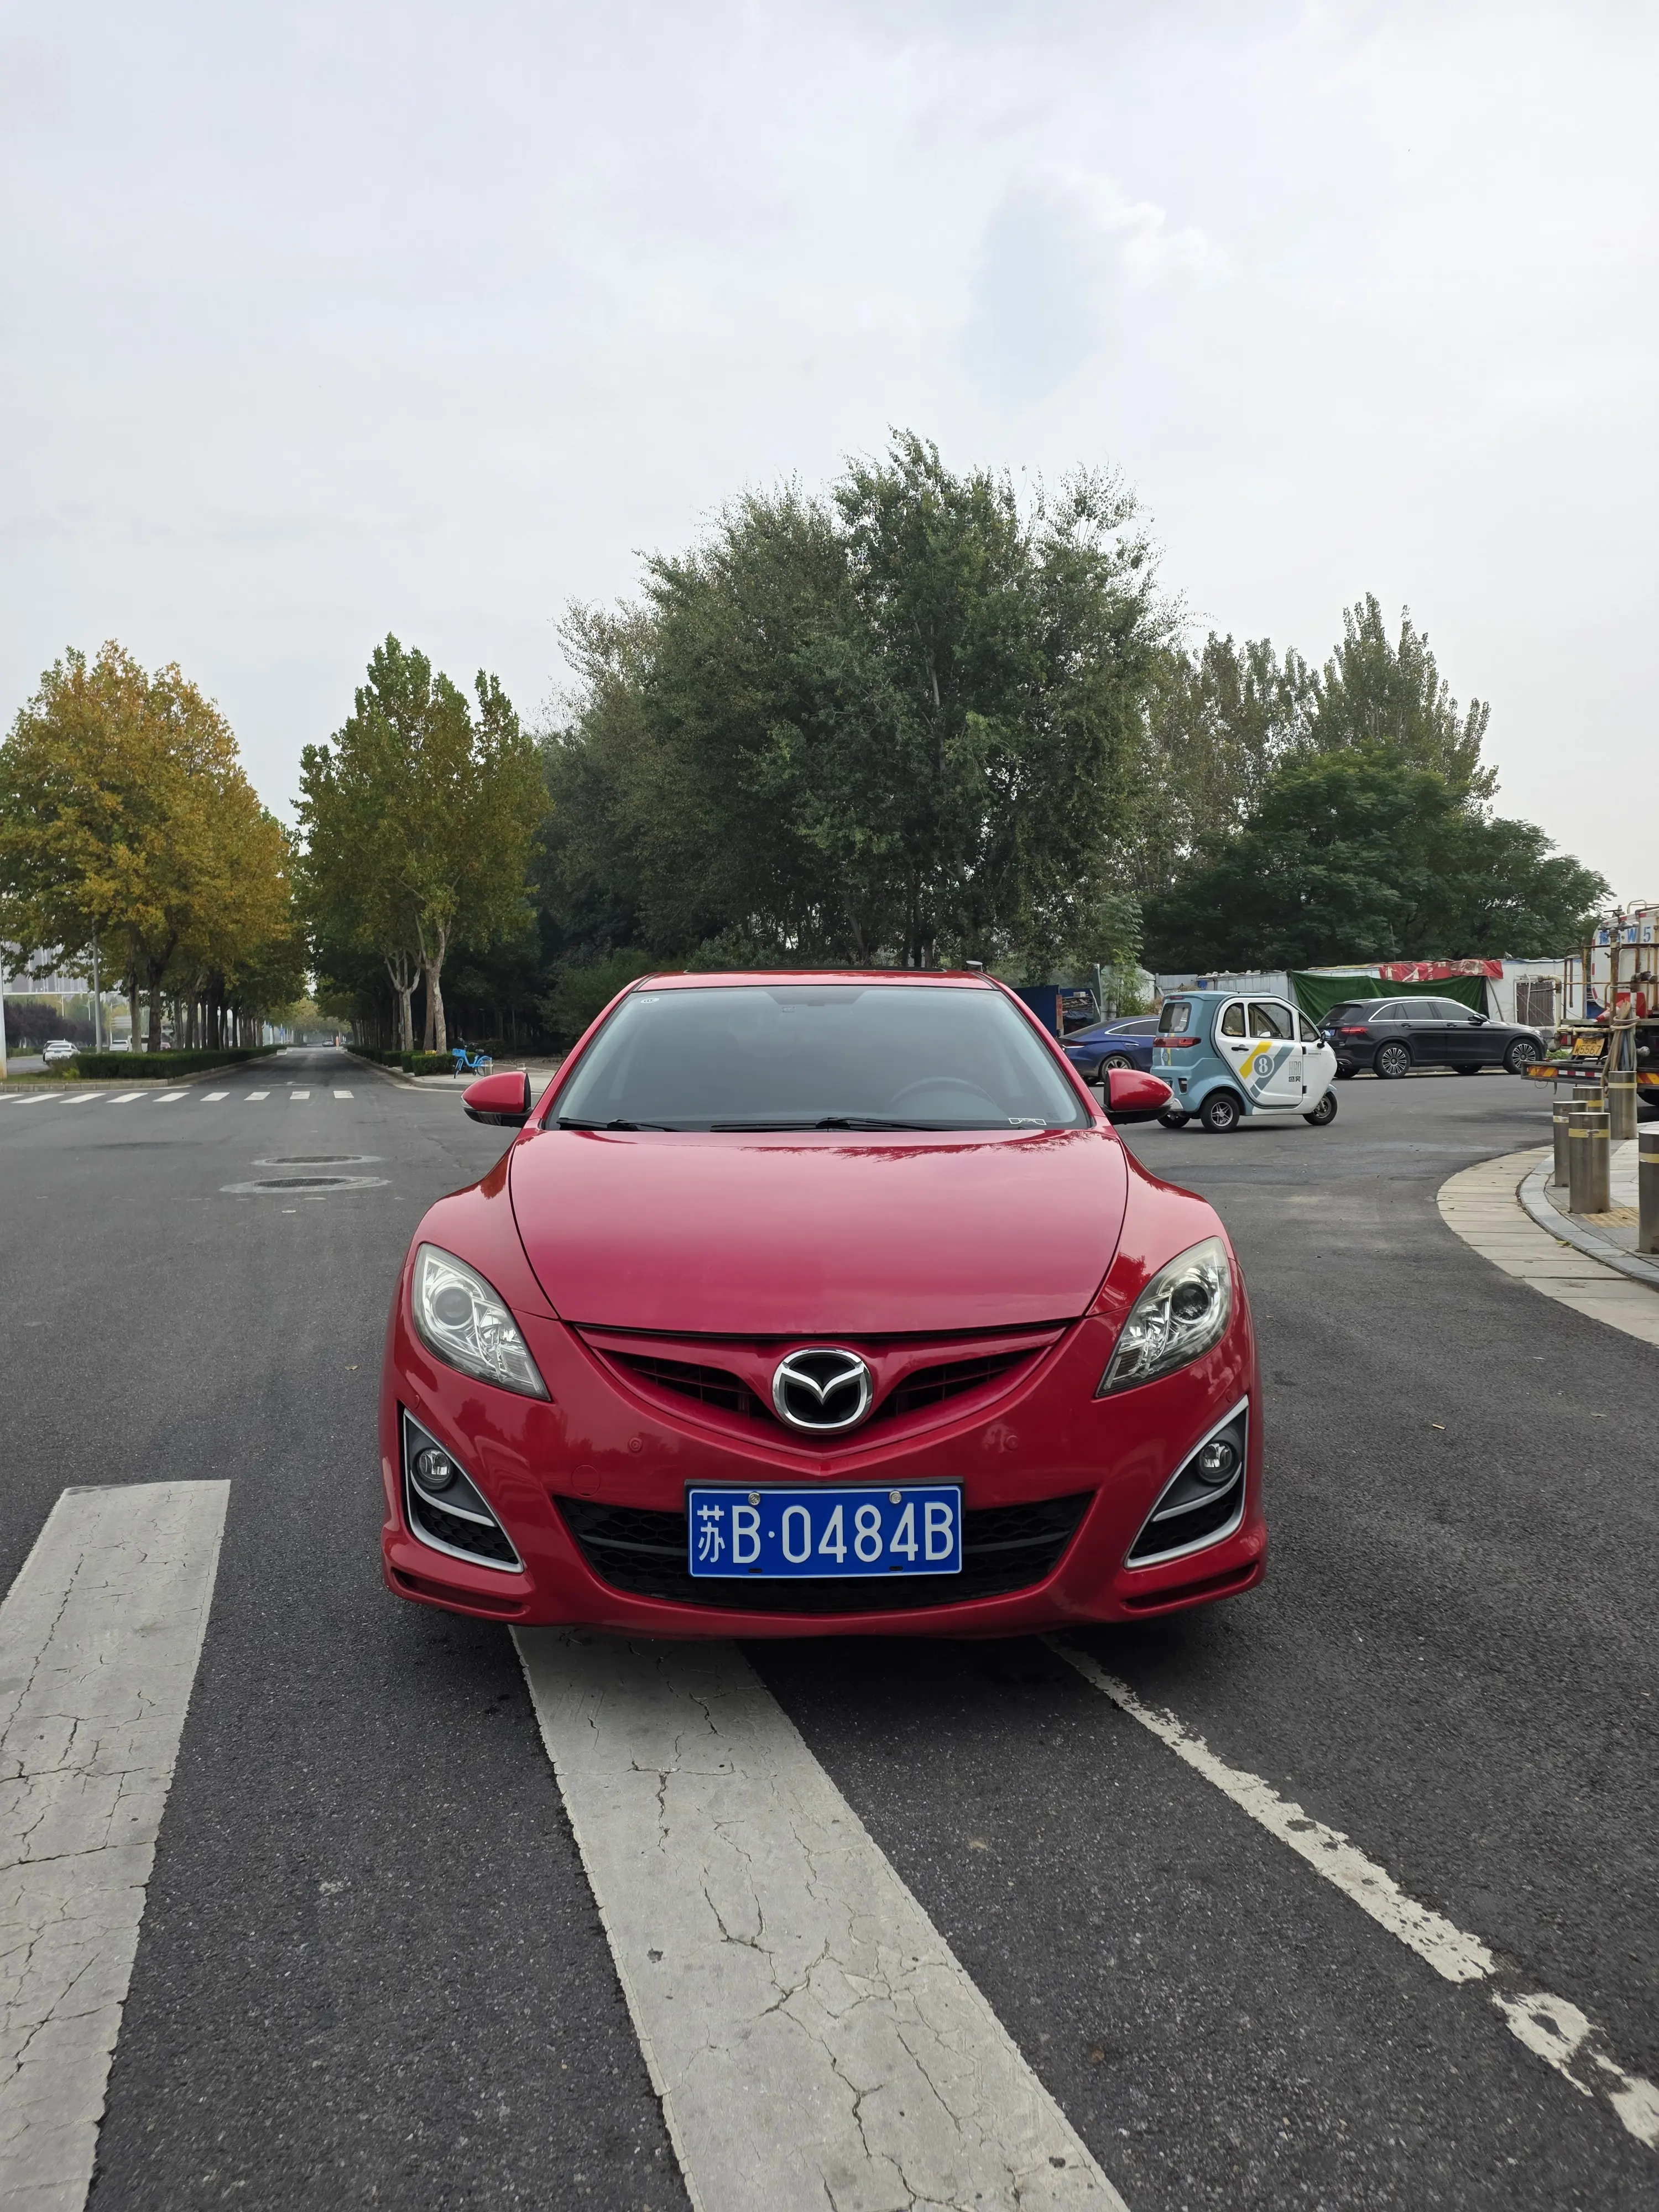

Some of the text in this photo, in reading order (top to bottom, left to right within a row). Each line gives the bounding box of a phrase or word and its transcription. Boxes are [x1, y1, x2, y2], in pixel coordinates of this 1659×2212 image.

[1574, 1045, 1601, 1054] W5567
[1259, 1057, 1268, 1073] 8
[697, 1502, 954, 1563] 苏B·0484B
